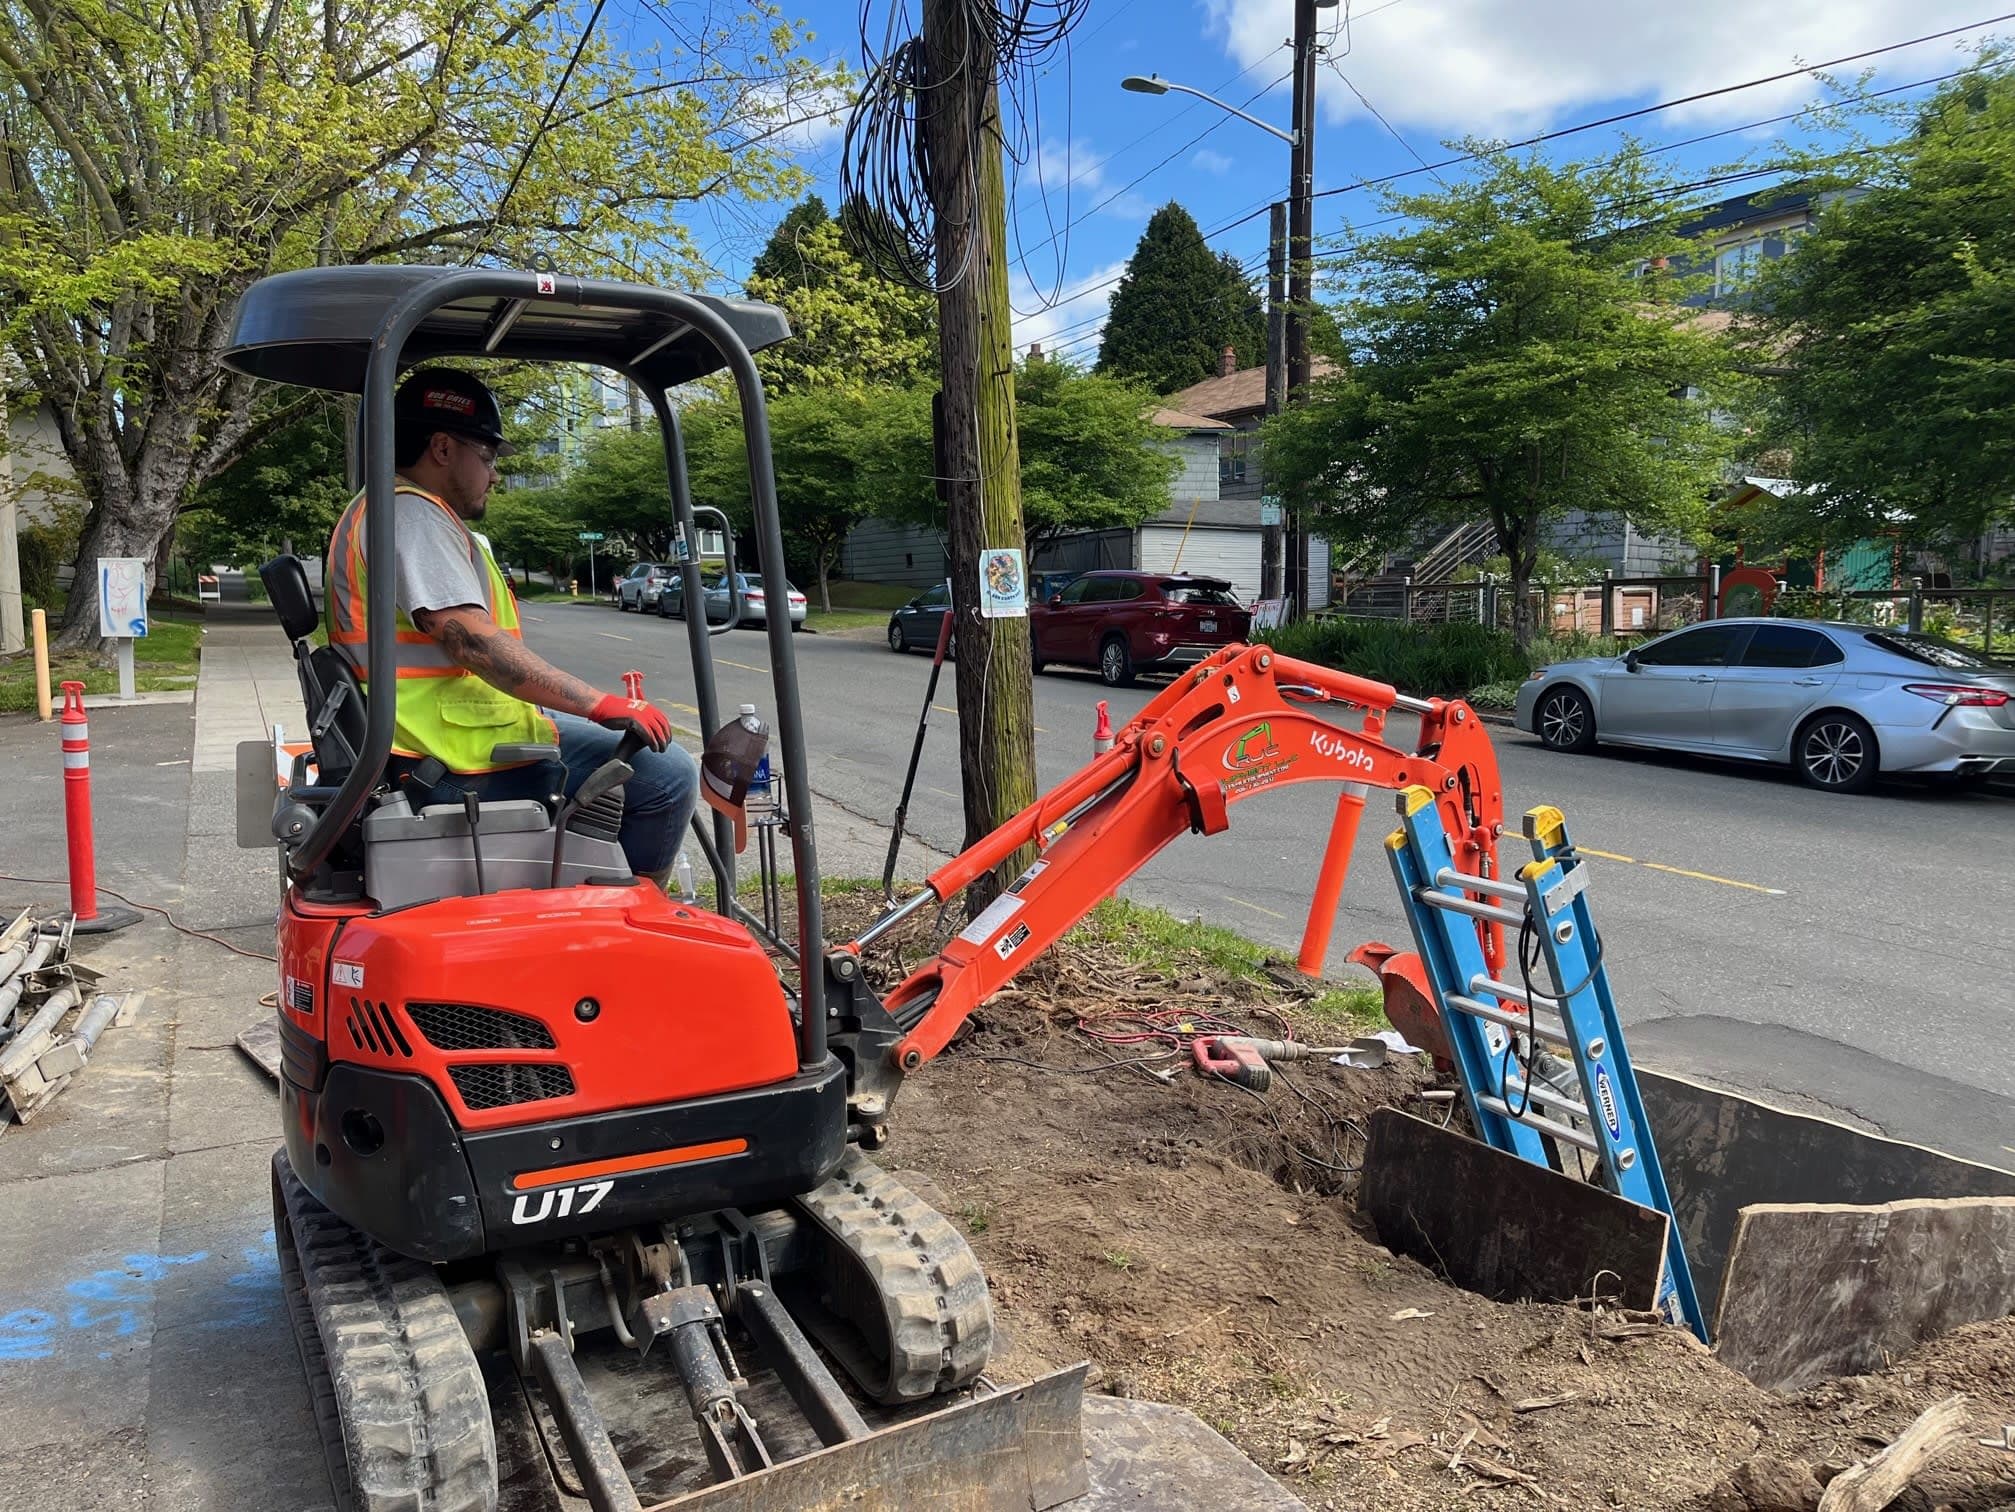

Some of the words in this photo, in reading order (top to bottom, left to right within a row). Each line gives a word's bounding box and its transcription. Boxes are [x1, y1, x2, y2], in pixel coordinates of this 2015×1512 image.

[1310, 730, 1375, 772] Kubota
[1599, 1077, 1617, 1127] WERNER
[511, 1180, 615, 1225] U17
